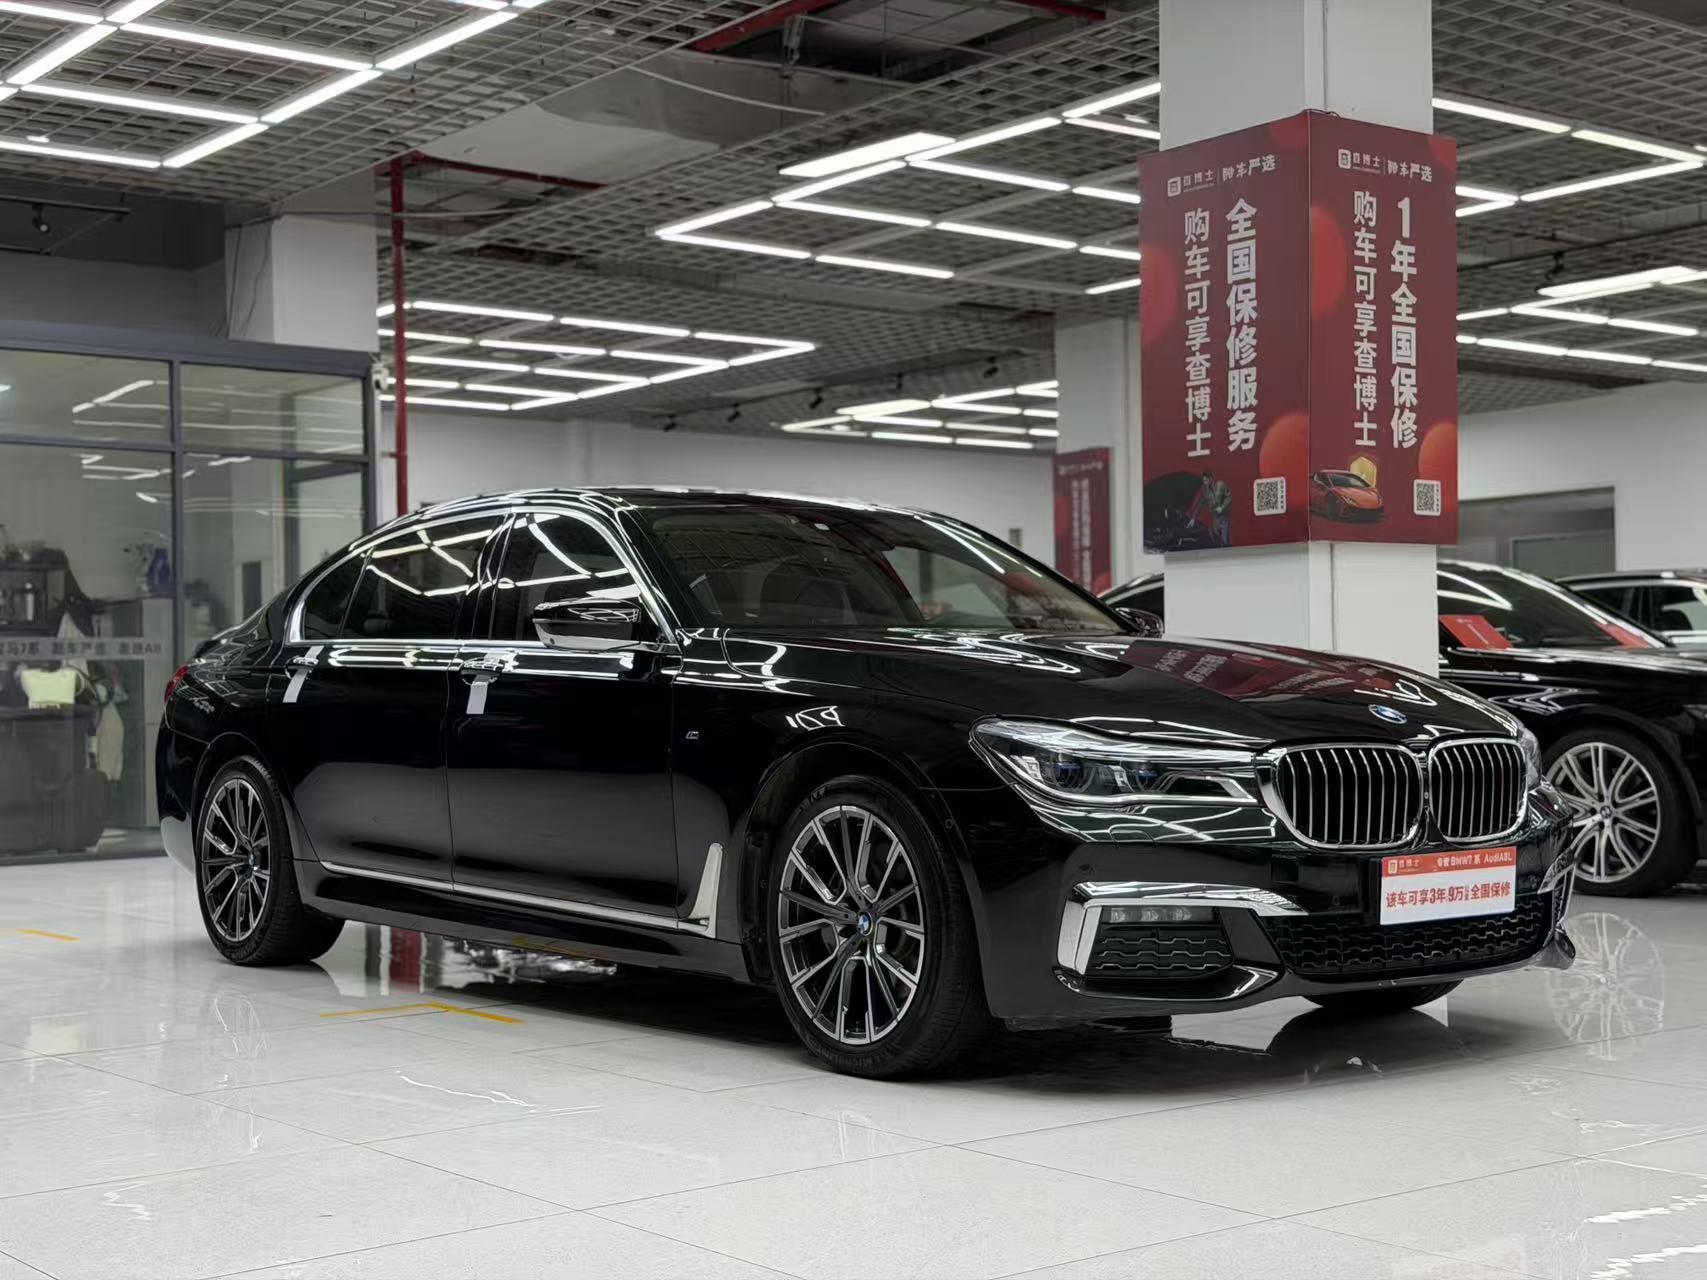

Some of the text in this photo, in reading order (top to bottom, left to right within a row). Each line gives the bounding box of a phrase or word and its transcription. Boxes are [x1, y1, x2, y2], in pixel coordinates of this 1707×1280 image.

[1184, 207, 1211, 458] 购车可享查博士
[1225, 198, 1258, 452] 全国保修服务
[1353, 190, 1378, 447] 购车可享查博士
[1390, 196, 1418, 449] 1年全国保修
